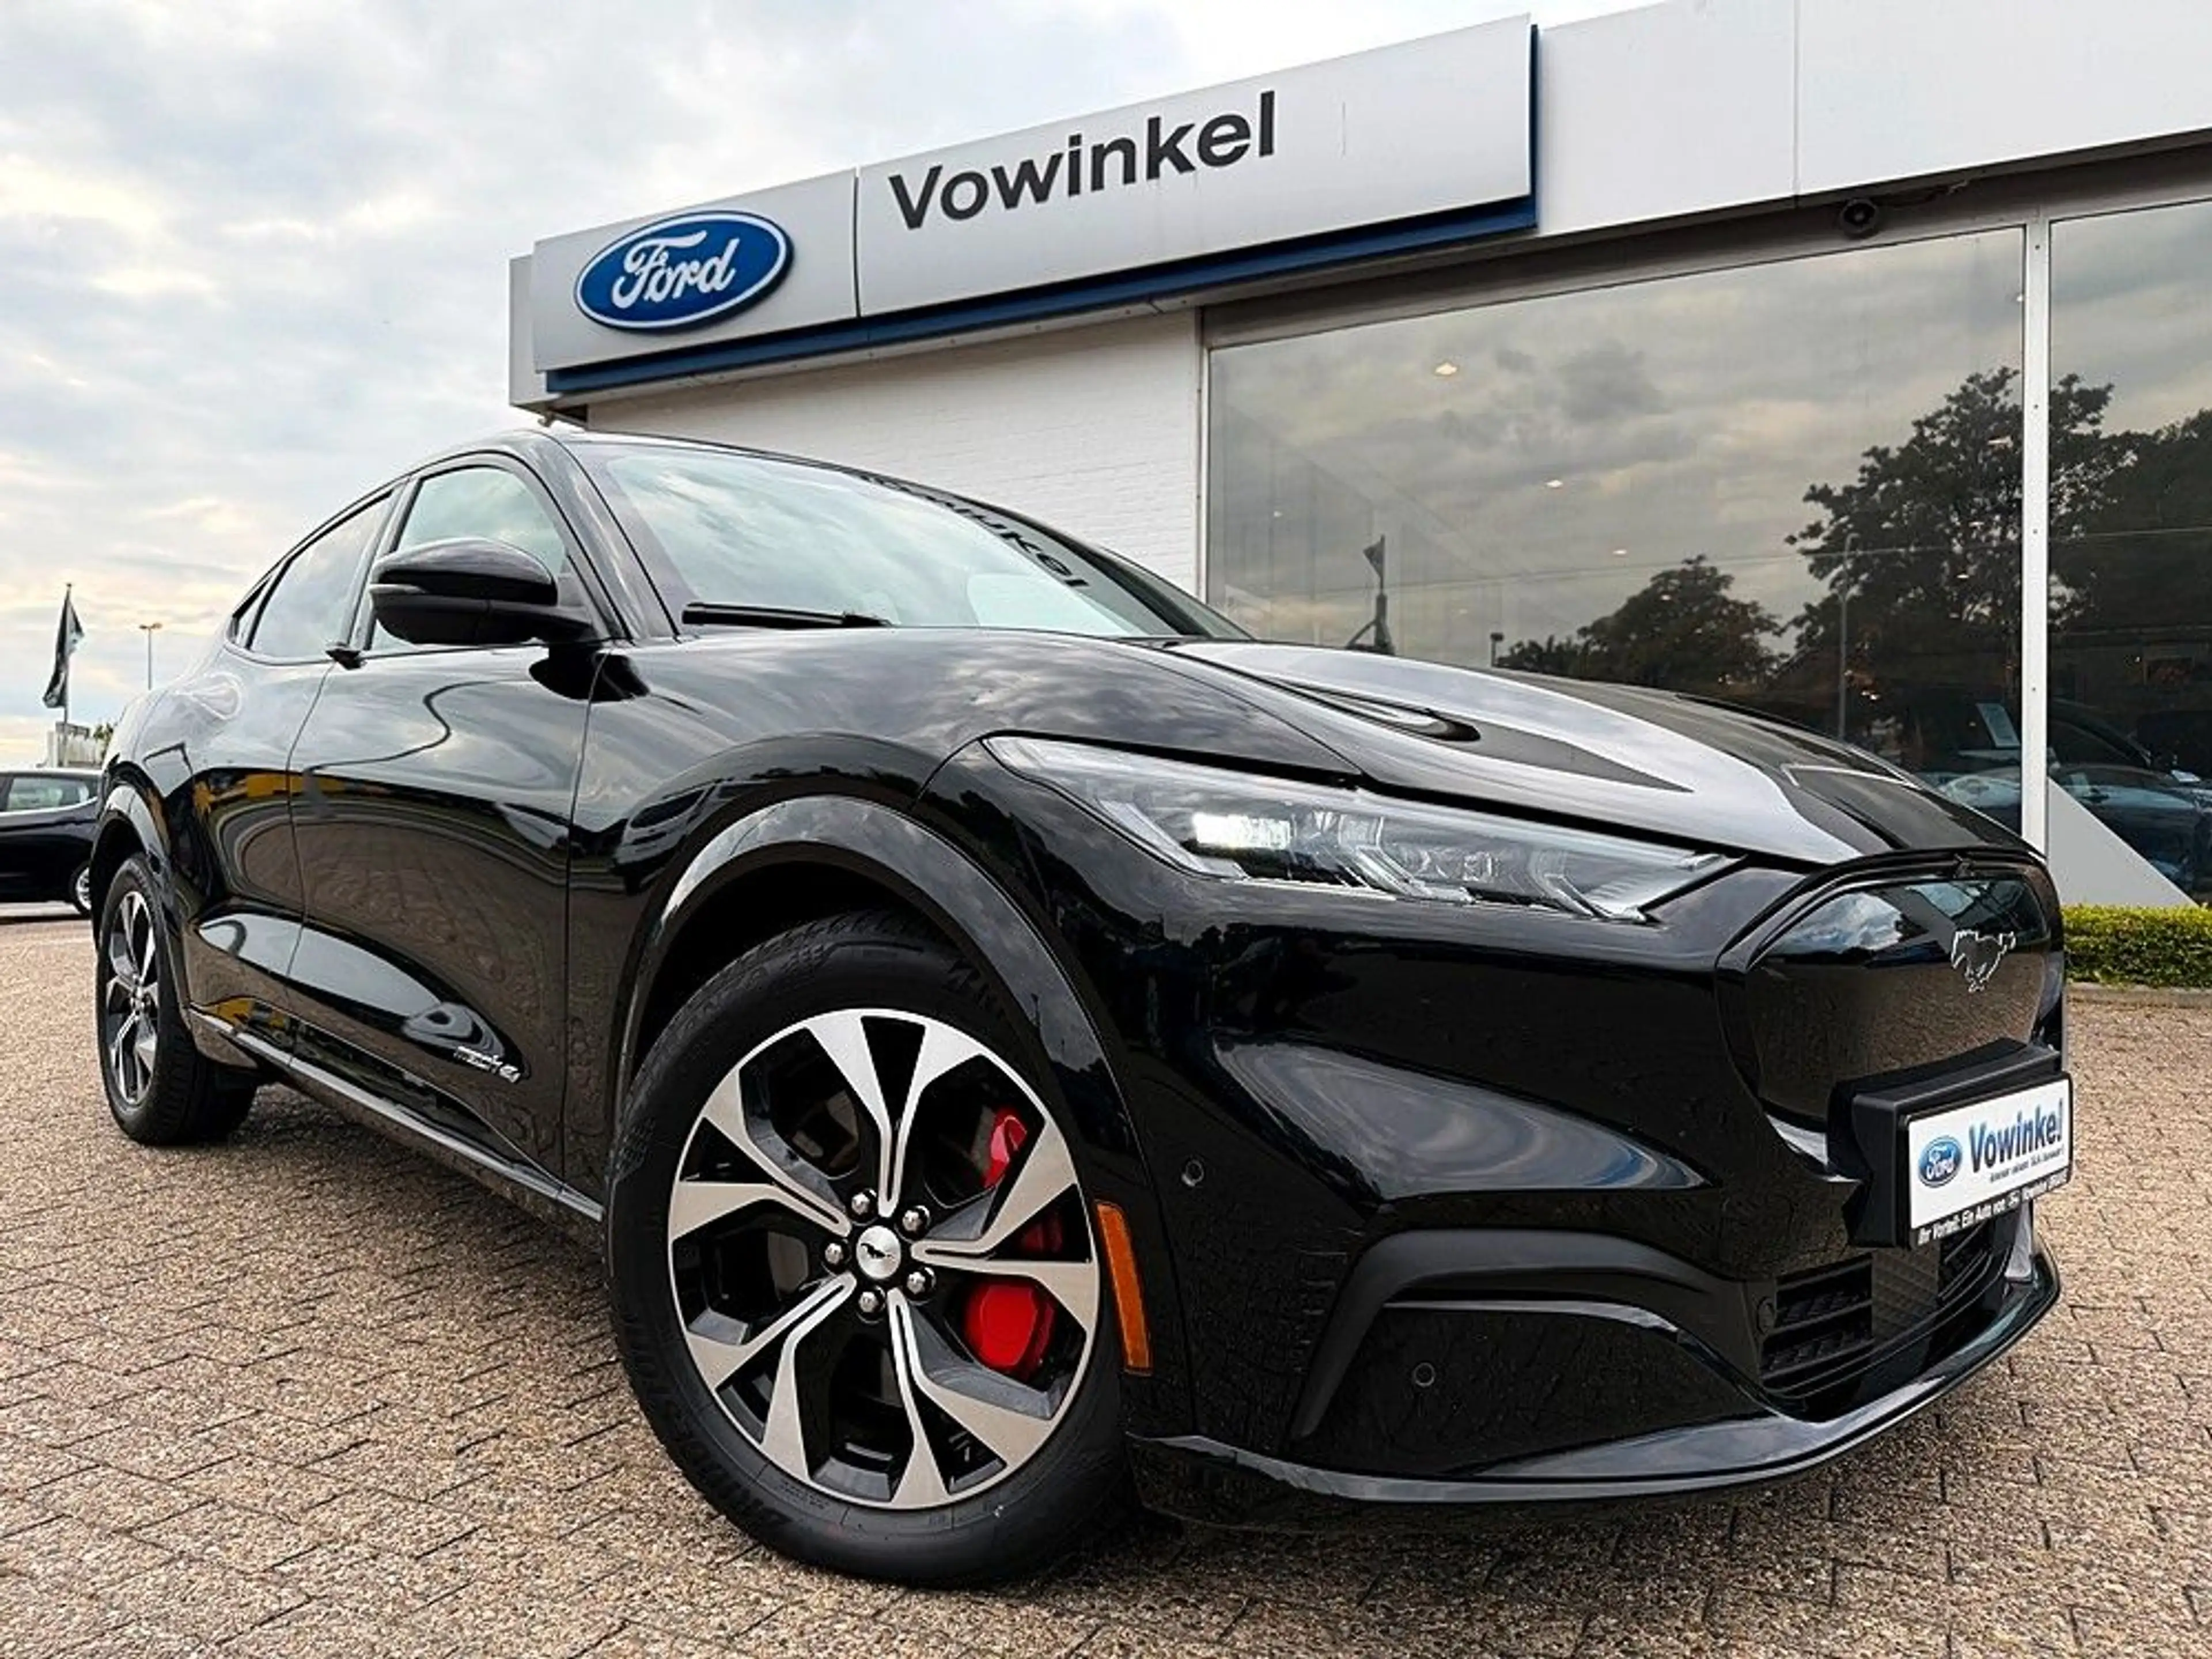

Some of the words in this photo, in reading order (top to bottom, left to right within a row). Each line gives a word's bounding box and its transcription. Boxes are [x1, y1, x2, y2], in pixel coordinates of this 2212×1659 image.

[889, 90, 1275, 230] Vowinkel
[612, 230, 740, 308] Ford
[1968, 1097, 2063, 1173] Vowinkel
